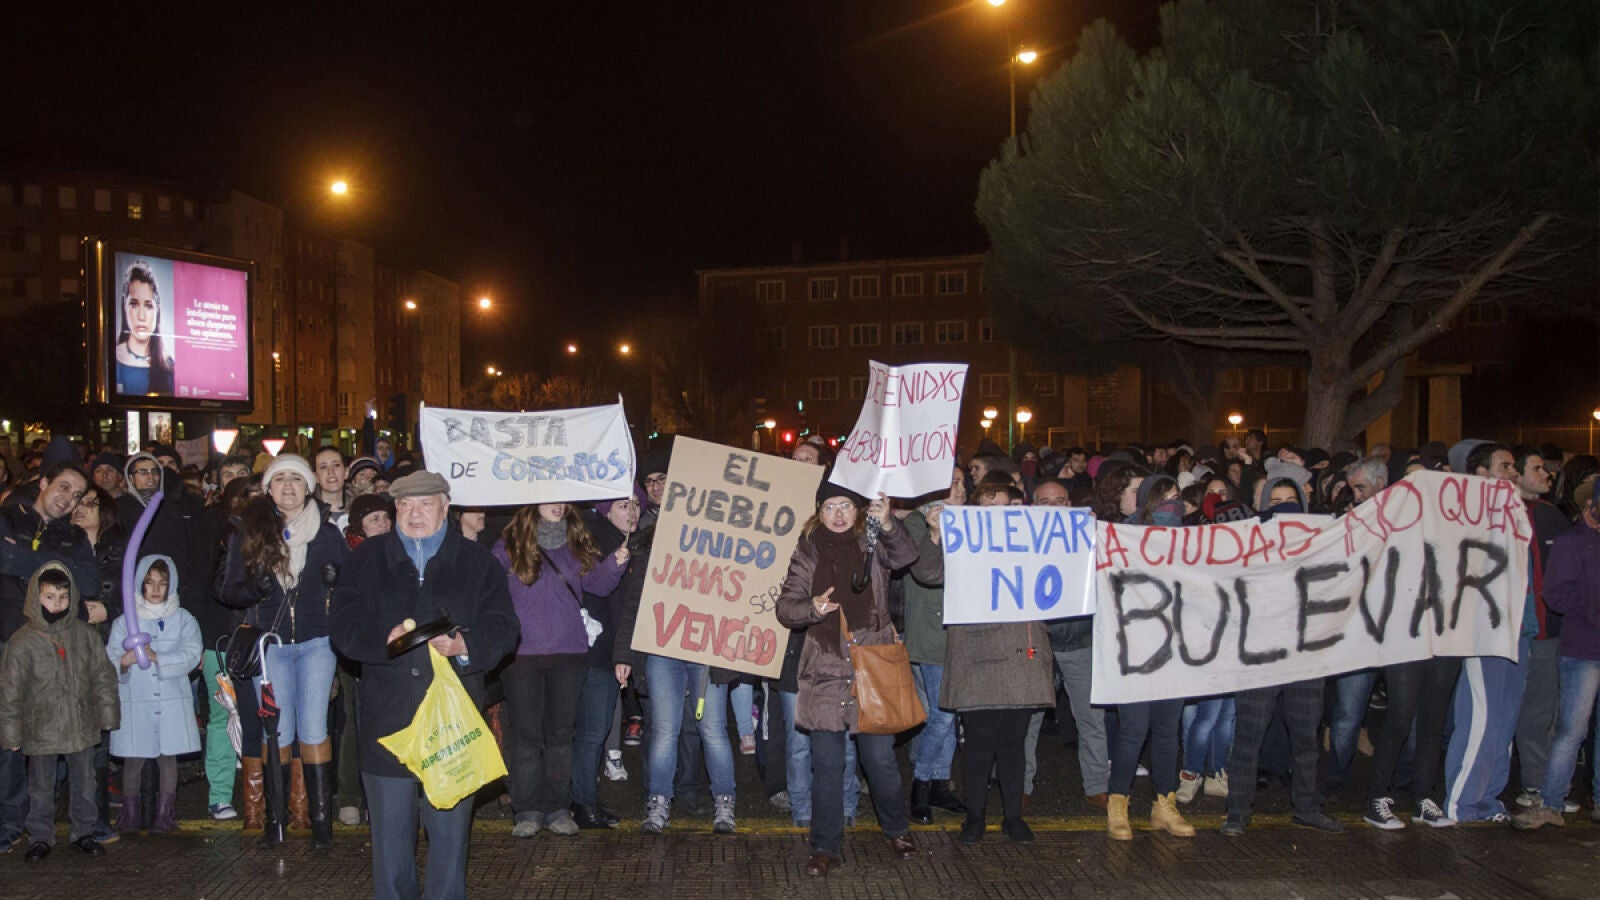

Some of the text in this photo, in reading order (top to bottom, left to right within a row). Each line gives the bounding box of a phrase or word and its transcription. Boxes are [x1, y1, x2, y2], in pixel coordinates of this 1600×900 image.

[442, 415, 568, 449] BASTA
[838, 423, 958, 469] ABSOLUCIÓN
[450, 449, 627, 483] DE CORRUPTOS
[723, 452, 771, 492] EL
[664, 481, 796, 536] PUEBLO
[941, 508, 1096, 556] BULEVAR
[1139, 520, 1322, 568] CIUDAD
[1344, 479, 1423, 557] NO
[679, 524, 777, 570] UNIDO
[652, 553, 746, 602] JAMÁS
[749, 577, 785, 615] SER
[991, 563, 1064, 612] NO
[1108, 537, 1510, 676] BULEVAR
